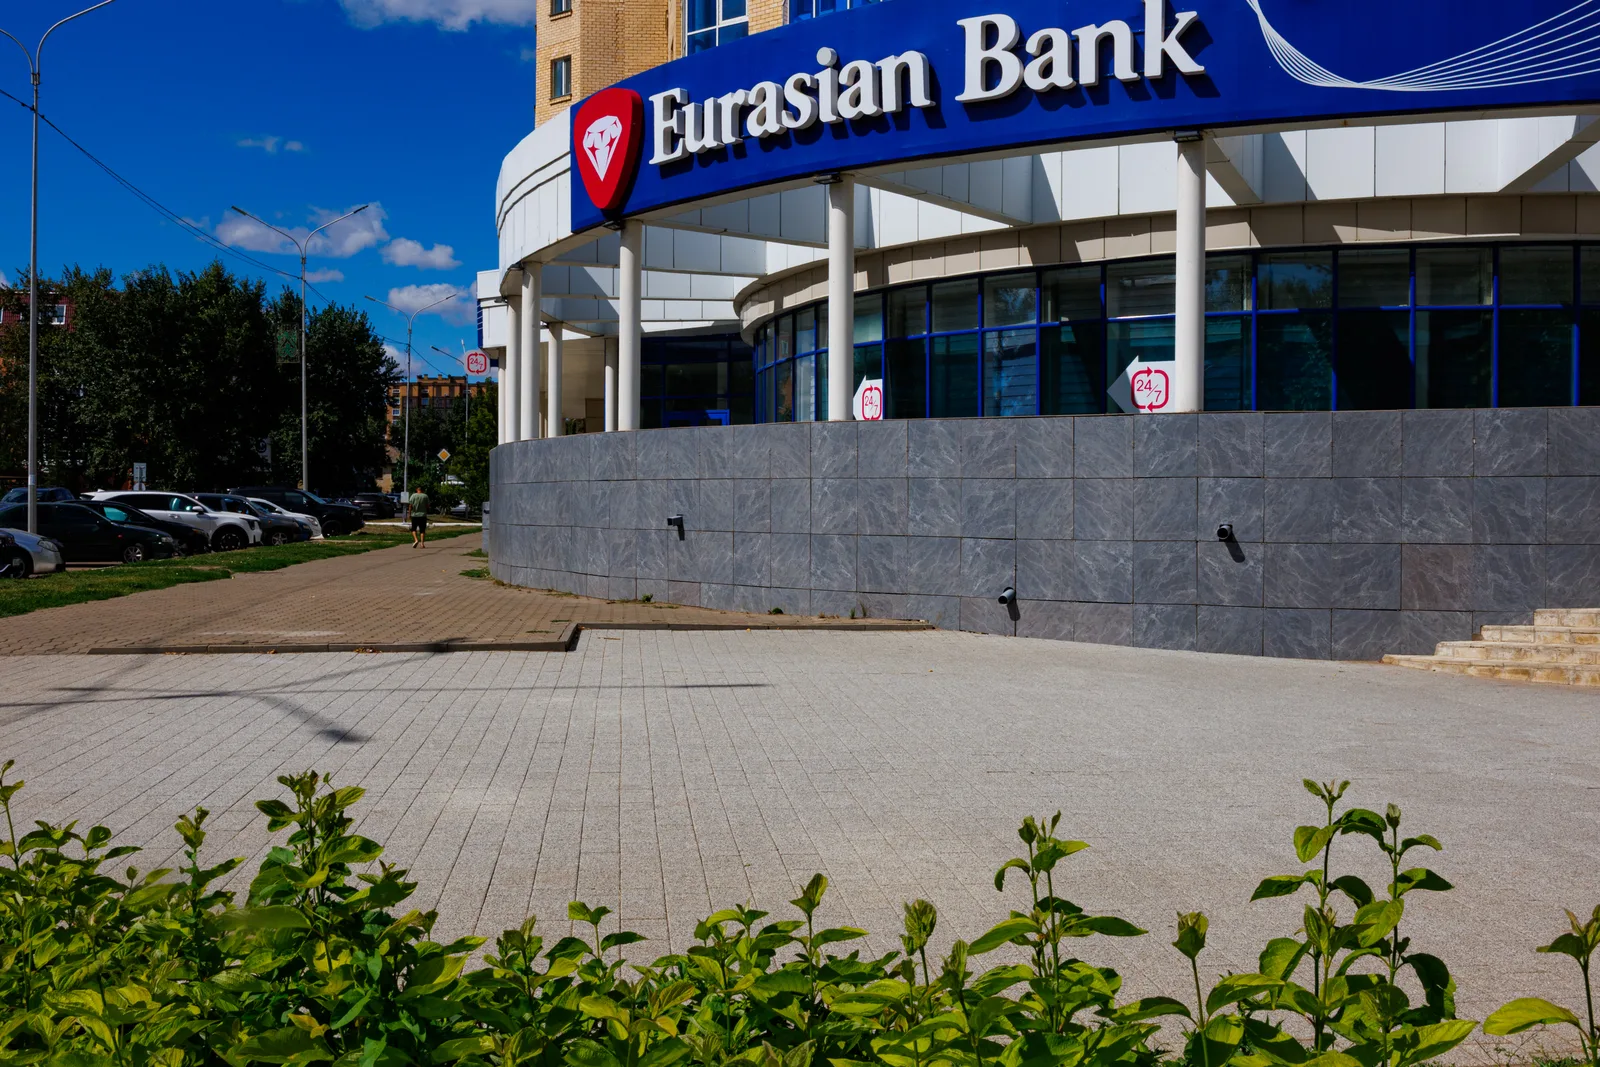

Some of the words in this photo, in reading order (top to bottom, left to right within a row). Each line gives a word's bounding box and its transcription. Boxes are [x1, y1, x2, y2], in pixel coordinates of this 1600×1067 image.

[649, 47, 936, 165] Eurasian
[955, 0, 1205, 102] Bank
[470, 357, 484, 370] 24/7
[1136, 379, 1162, 403] 24/7
[864, 395, 879, 416] 24/7
